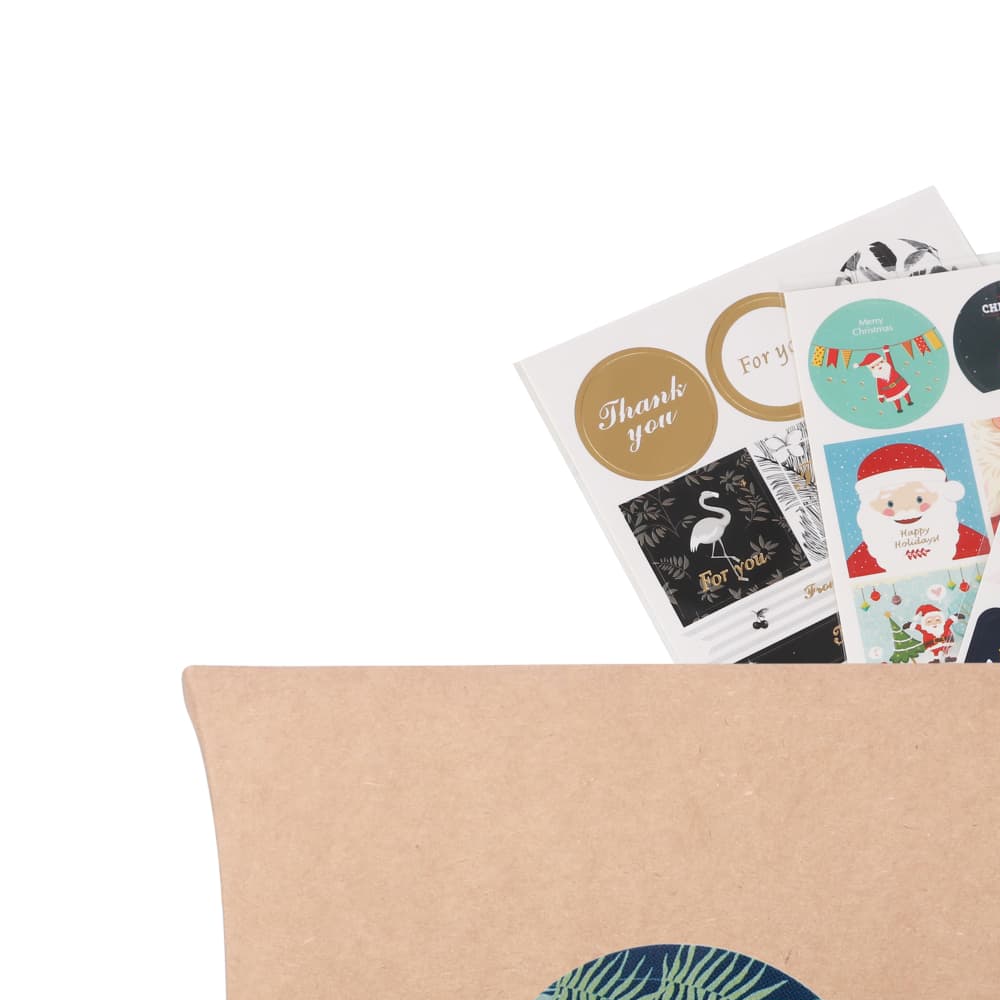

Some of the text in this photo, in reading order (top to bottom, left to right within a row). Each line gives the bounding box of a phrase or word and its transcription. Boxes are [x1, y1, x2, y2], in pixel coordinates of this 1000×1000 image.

[852, 324, 894, 336] Christmas
[737, 352, 770, 375] For
[598, 375, 687, 431] Thank
[626, 409, 678, 452] you
[900, 527, 930, 540] Happy
[698, 552, 768, 594] For you
